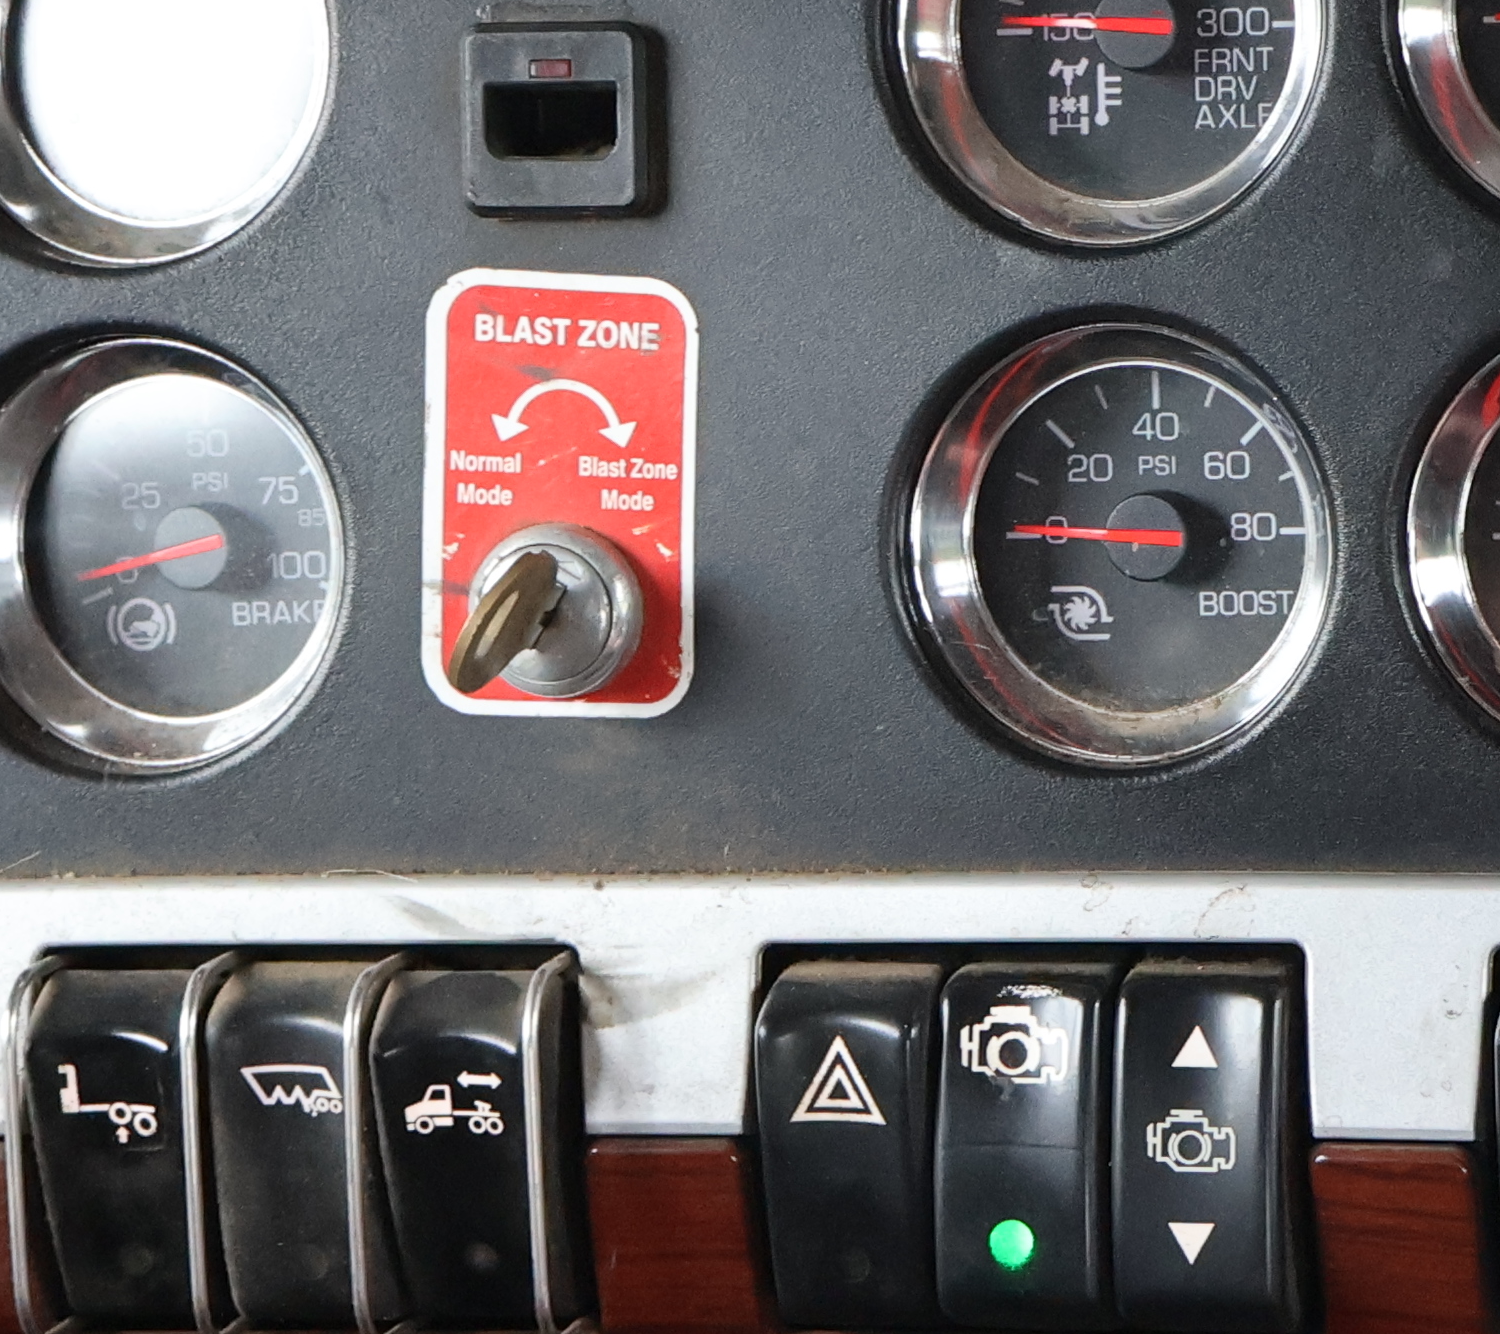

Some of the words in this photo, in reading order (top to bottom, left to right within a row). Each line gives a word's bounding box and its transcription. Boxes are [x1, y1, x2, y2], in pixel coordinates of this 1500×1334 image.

[1196, 7, 1270, 37] 300
[1194, 47, 1274, 73] FRNT
[1194, 76, 1258, 102] DRV
[474, 313, 571, 346] BLAST
[577, 319, 661, 351] ZONE
[1132, 411, 1180, 441] 40
[187, 429, 229, 457] 50
[450, 450, 522, 474] Normal
[578, 456, 627, 478] Blast
[630, 458, 678, 480] Zone
[1067, 453, 1113, 483] 20
[1138, 455, 1177, 475] PSI
[1203, 450, 1251, 480] 60
[192, 472, 228, 491] PSI
[258, 476, 299, 504] 75
[457, 483, 513, 505] Mode
[121, 482, 161, 509] 25
[601, 489, 654, 511] Mode
[1230, 512, 1277, 542] 80
[266, 551, 326, 579] 100
[1199, 590, 1295, 617] BOOST
